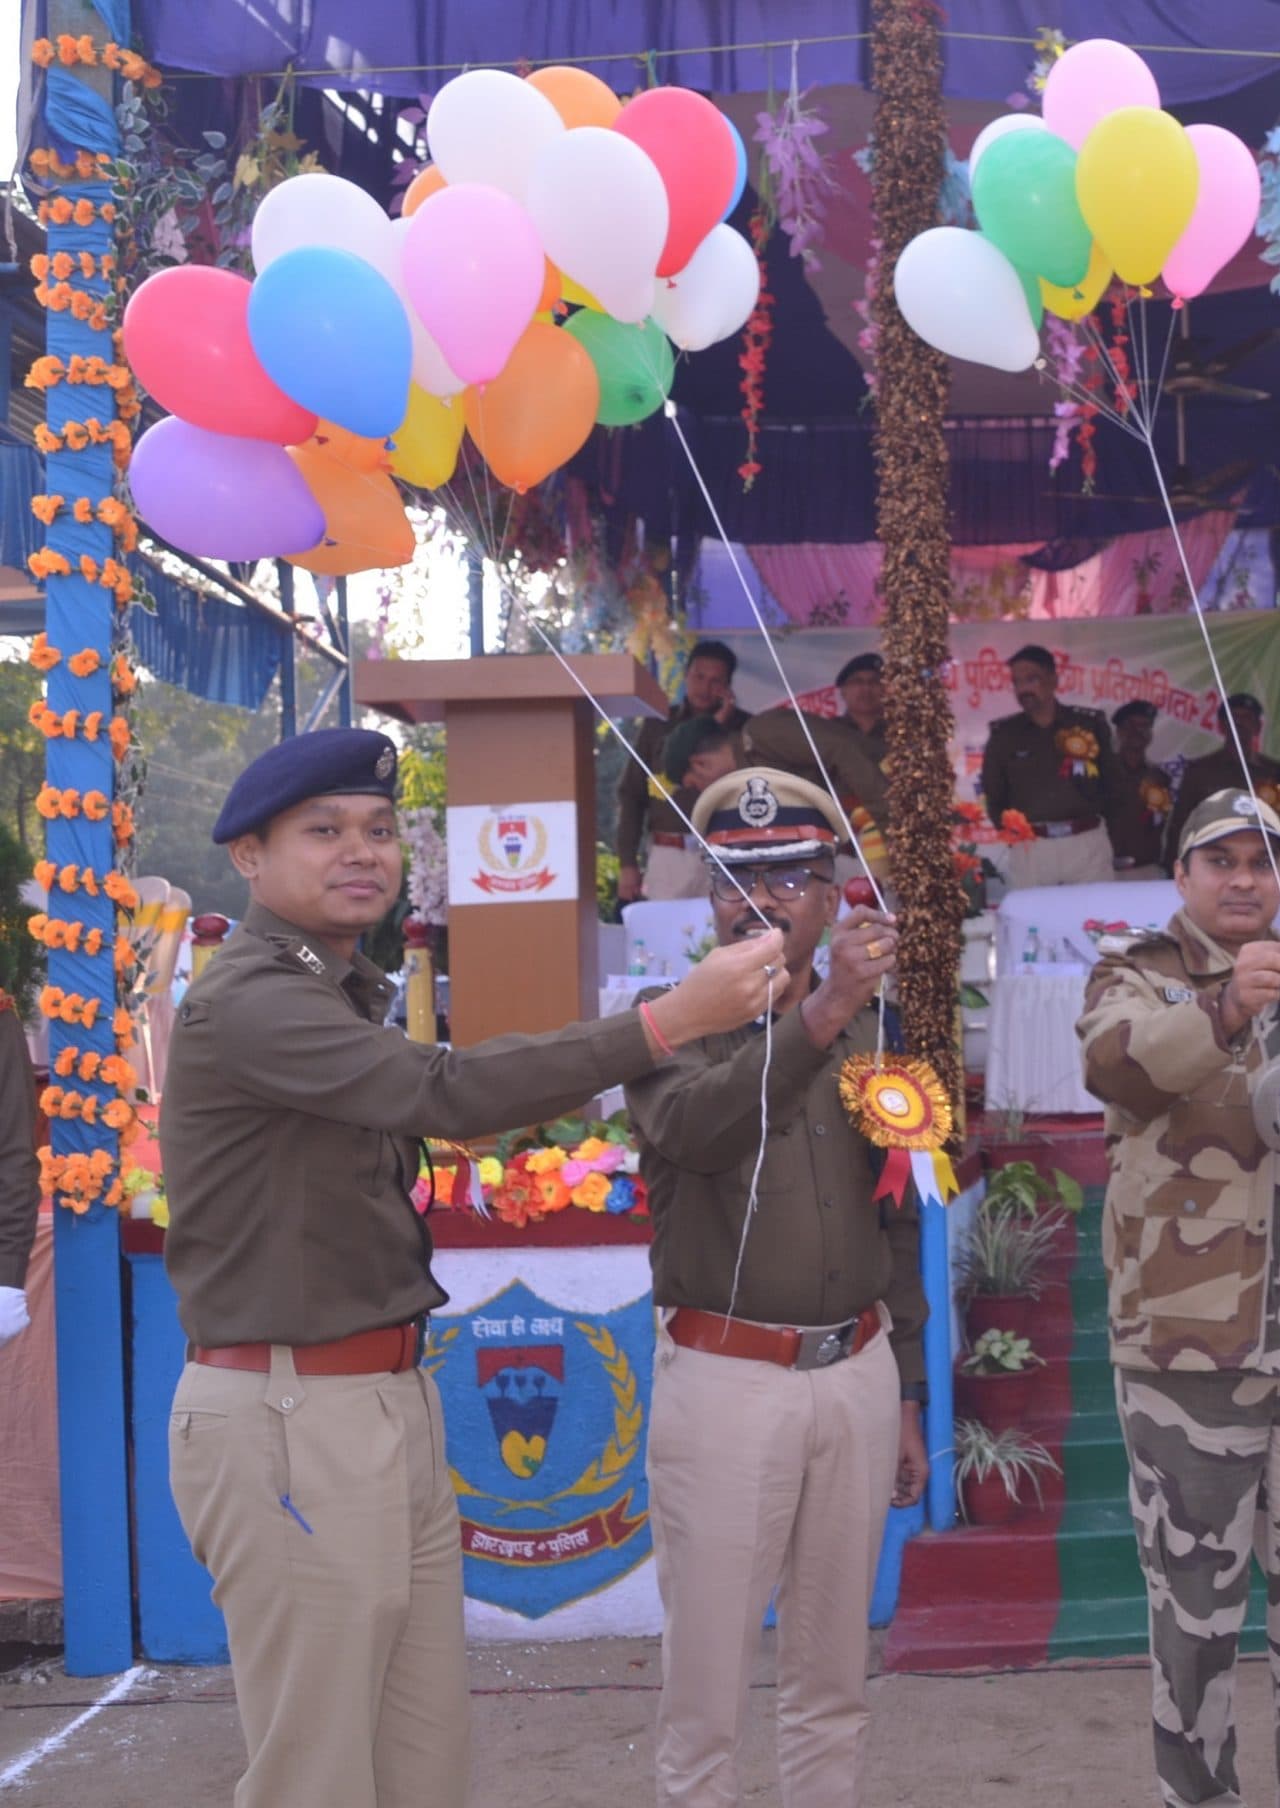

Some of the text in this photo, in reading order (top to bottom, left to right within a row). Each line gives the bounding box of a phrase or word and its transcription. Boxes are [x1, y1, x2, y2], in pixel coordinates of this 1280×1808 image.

[471, 1315, 507, 1338] सेवा
[511, 1314, 526, 1337] ही
[545, 1528, 590, 1560] पुलिस
